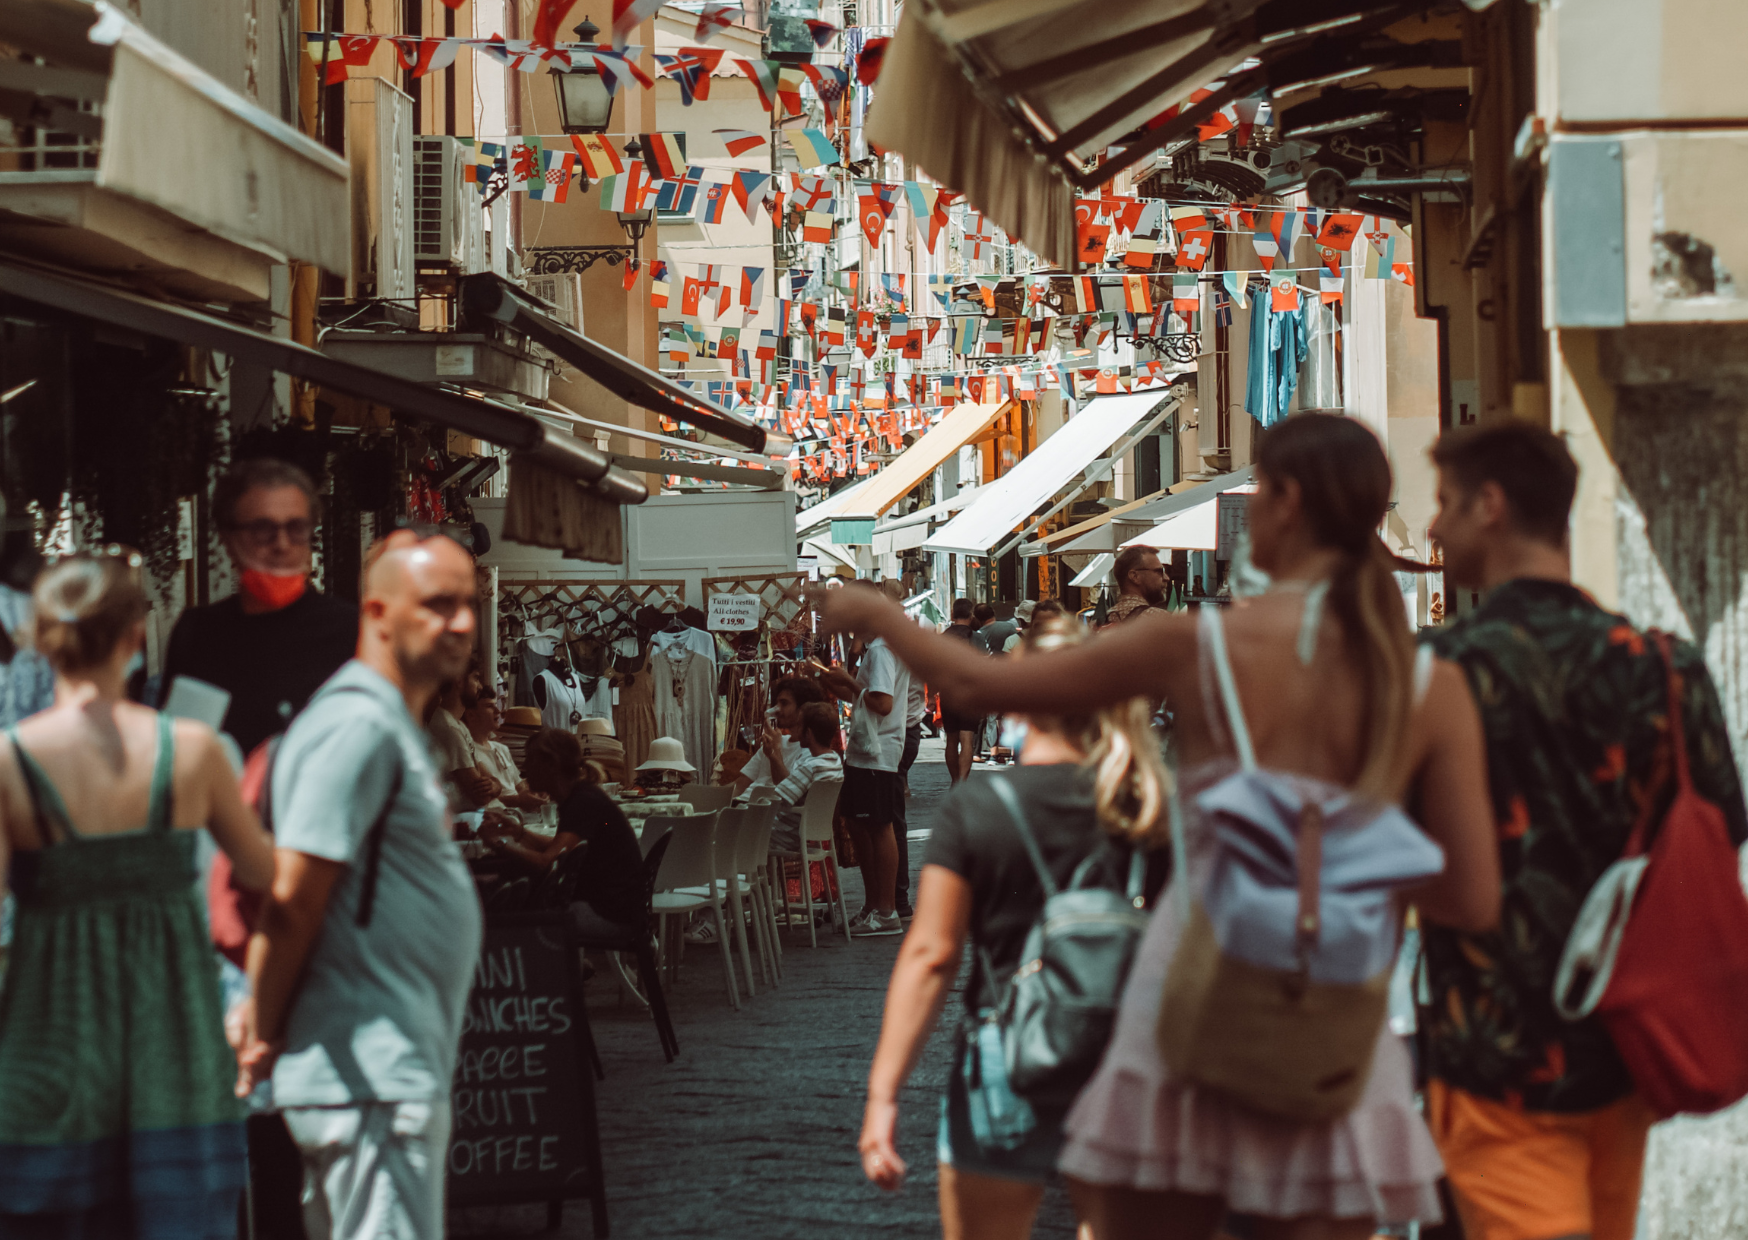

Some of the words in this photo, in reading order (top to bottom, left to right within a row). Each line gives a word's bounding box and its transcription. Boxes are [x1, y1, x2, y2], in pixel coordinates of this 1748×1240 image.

[726, 618, 745, 626] 19,90
[454, 1086, 548, 1130] RUIT
[450, 1135, 560, 1175] OFFEE
